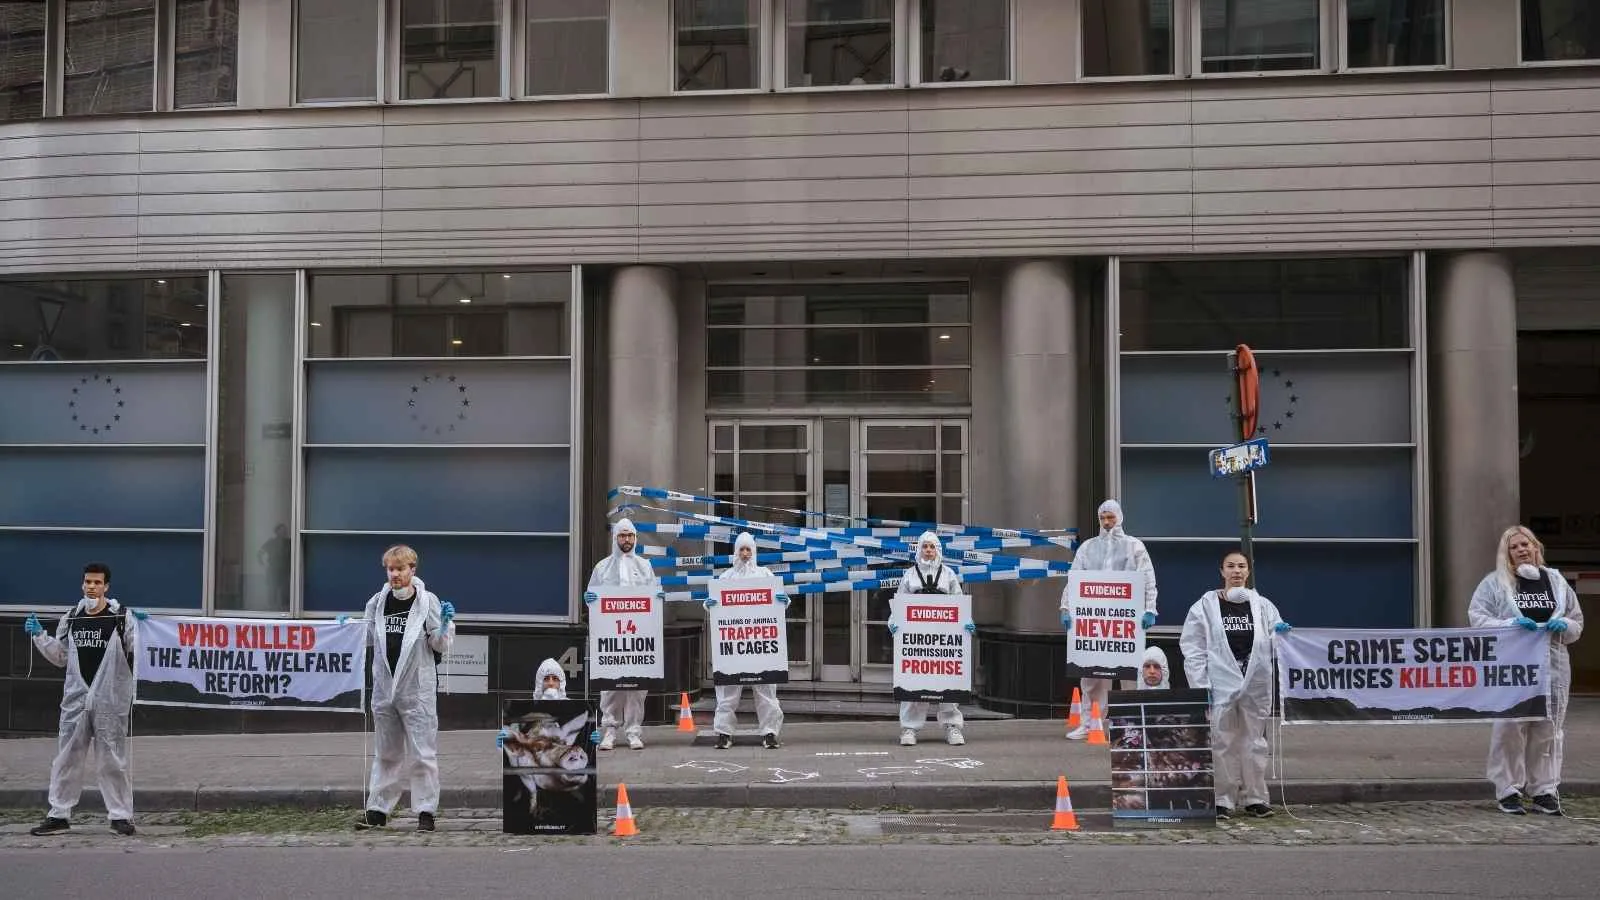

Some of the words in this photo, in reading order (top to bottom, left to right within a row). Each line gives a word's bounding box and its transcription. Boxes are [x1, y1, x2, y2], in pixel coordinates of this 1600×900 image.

[725, 592, 768, 604] EVIDENCE
[1083, 585, 1128, 597] EVIDENCE
[605, 600, 647, 611] EVIDENCE
[1075, 607, 1093, 617] BAN
[1094, 608, 1107, 617] ON
[1108, 608, 1136, 618] CAGES
[718, 618, 744, 626] MILLIONS
[753, 617, 777, 625] ANIMALS
[911, 609, 955, 620] EVIDENCE
[1222, 614, 1249, 624] nimal
[615, 619, 637, 635] 1.4
[718, 625, 778, 641] TRAPPED
[1075, 619, 1137, 639] NEVER
[177, 623, 228, 647] WHO
[236, 625, 316, 650] KILLED
[902, 633, 963, 646] EUROPEAN
[598, 637, 655, 653] MILLION
[719, 642, 733, 656] IN
[737, 640, 779, 655] CAGES
[902, 648, 963, 658] COMMISSION'S
[1075, 640, 1136, 653] DELIVERED
[1327, 638, 1405, 665] CRIME
[1413, 636, 1498, 663] SCENE
[147, 647, 183, 668] THE
[187, 649, 259, 671] ANIMAL
[265, 651, 353, 673] WELFARE
[559, 646, 583, 679] 4
[598, 654, 656, 665] SIGNATURES
[901, 659, 963, 676] PROMISE
[205, 672, 292, 695] REFORM?
[1288, 667, 1394, 691] PROMISES
[1399, 665, 1477, 690] KILLED
[1484, 663, 1540, 687] HERE
